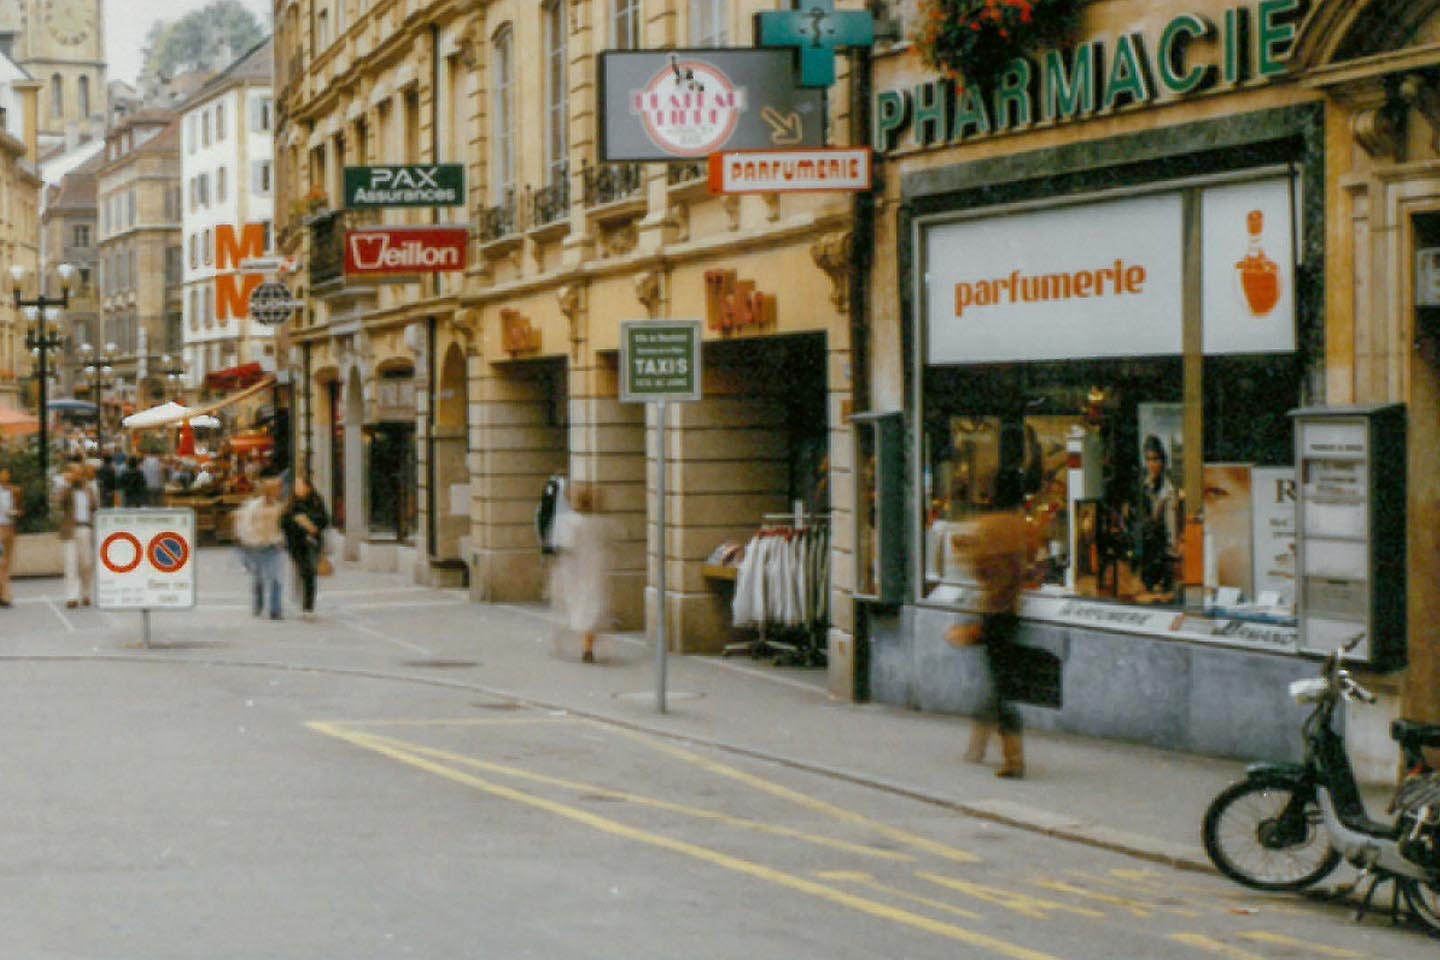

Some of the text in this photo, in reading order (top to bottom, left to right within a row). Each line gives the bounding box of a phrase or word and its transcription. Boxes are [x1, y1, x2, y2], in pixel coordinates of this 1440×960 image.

[370, 167, 439, 189] PAX
[353, 187, 456, 204] Assurances
[954, 258, 1146, 319] parfumerie
[634, 358, 688, 375] TAXIS
